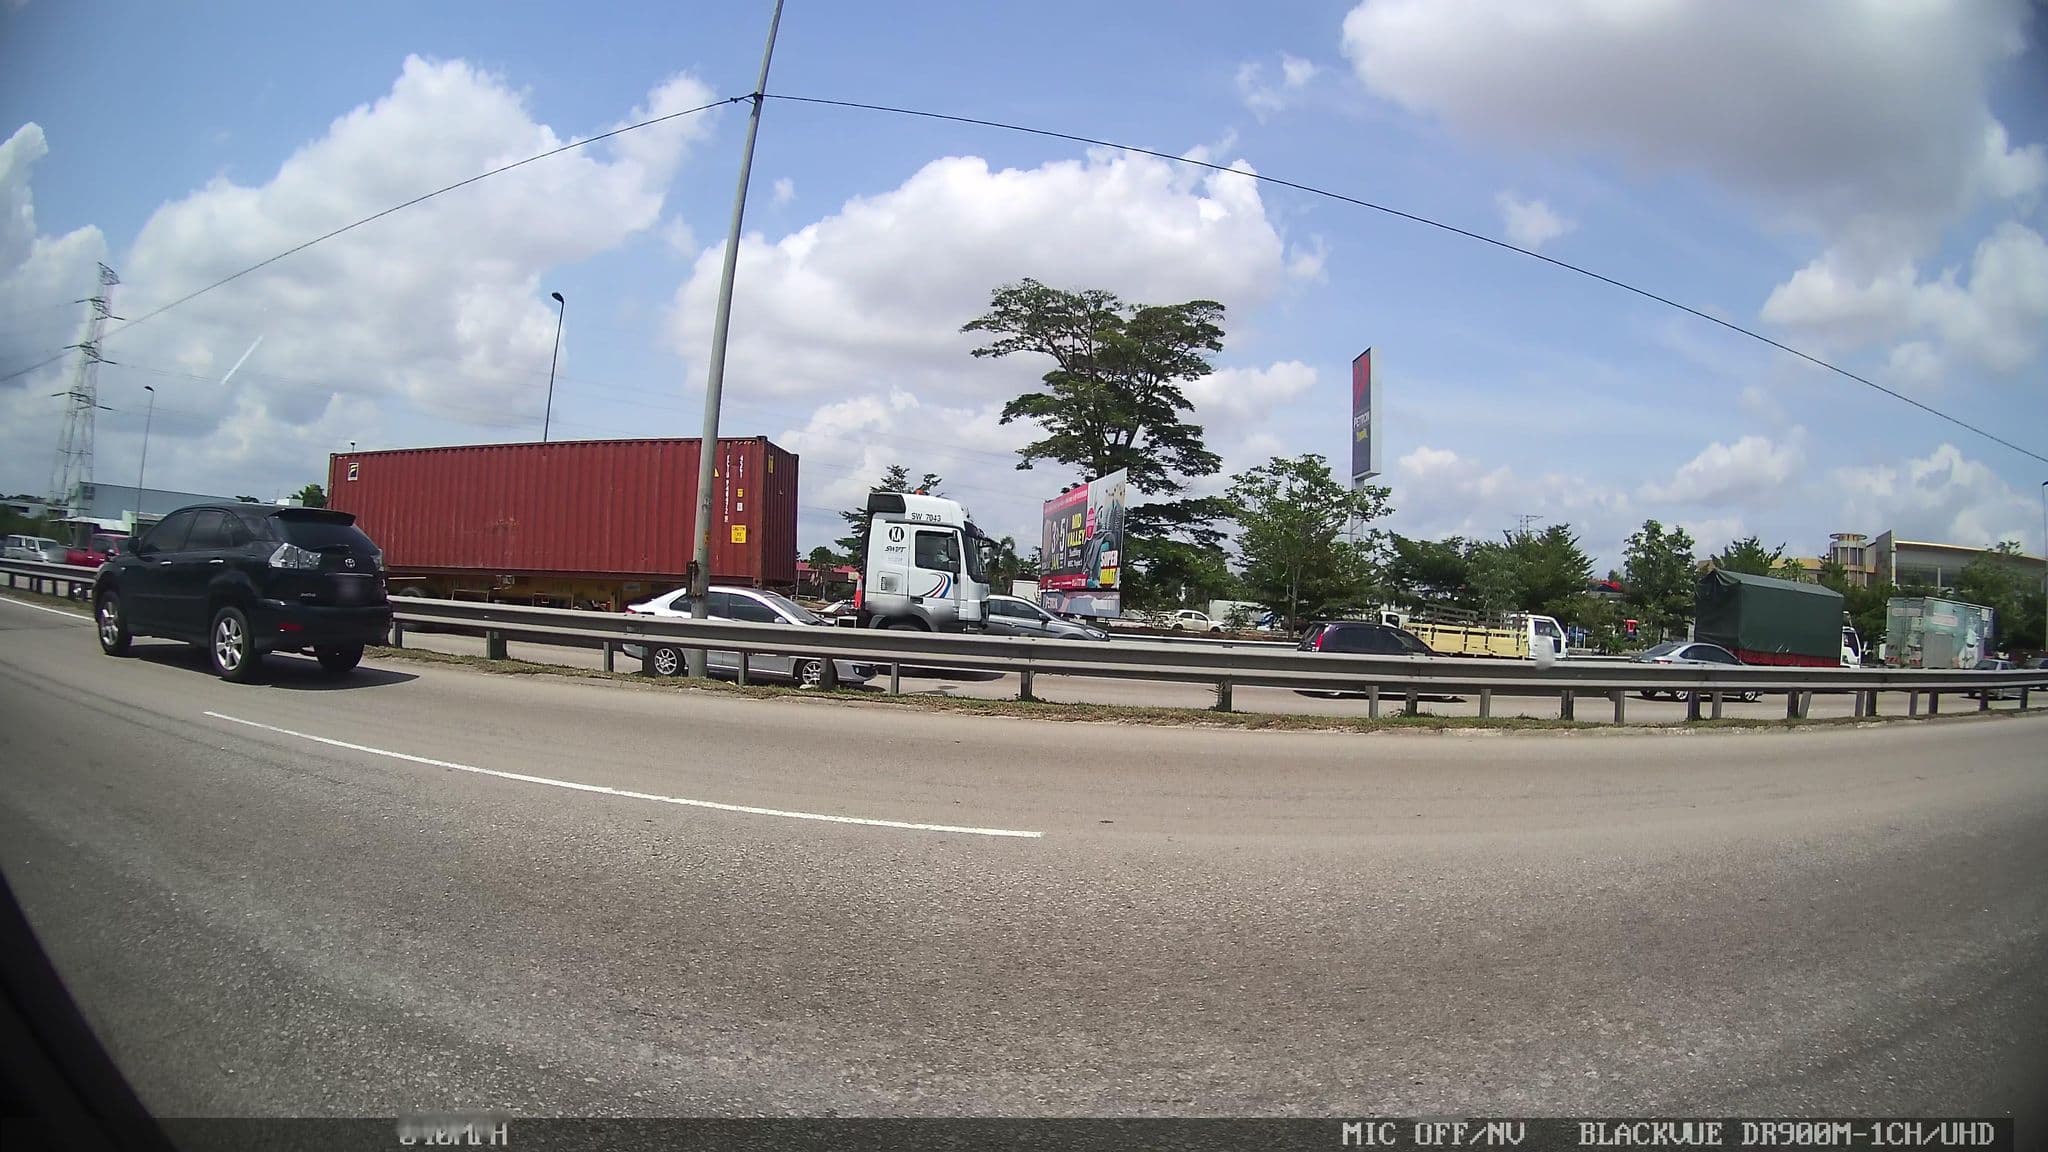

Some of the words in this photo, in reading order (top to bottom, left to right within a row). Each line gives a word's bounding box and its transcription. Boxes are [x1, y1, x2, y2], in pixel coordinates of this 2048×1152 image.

[911, 512, 923, 520] SW
[925, 513, 942, 522] 7043
[1067, 530, 1086, 548] VALLEY
